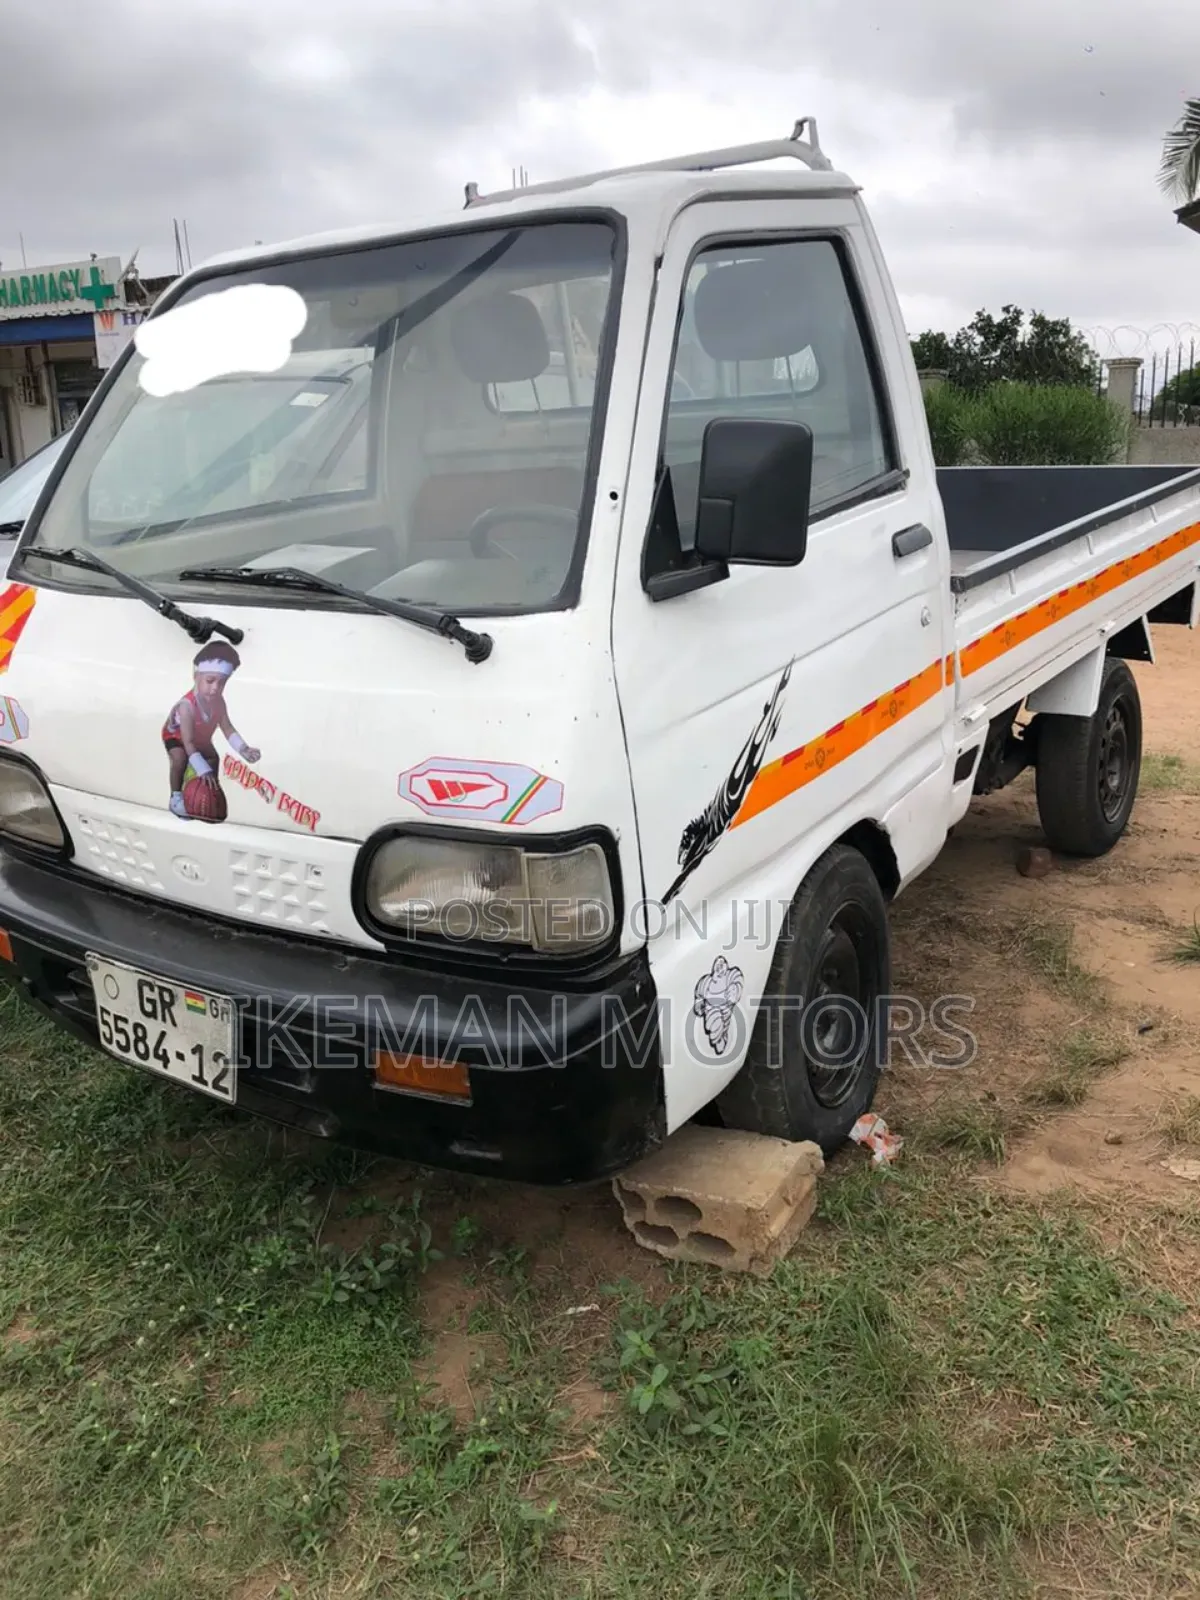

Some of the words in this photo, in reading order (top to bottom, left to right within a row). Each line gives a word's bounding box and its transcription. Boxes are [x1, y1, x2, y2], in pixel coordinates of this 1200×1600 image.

[0, 268, 81, 309] HARMACY
[278, 791, 321, 832] BABY
[136, 978, 178, 1028] GR
[99, 1005, 230, 1096] 5584-12
